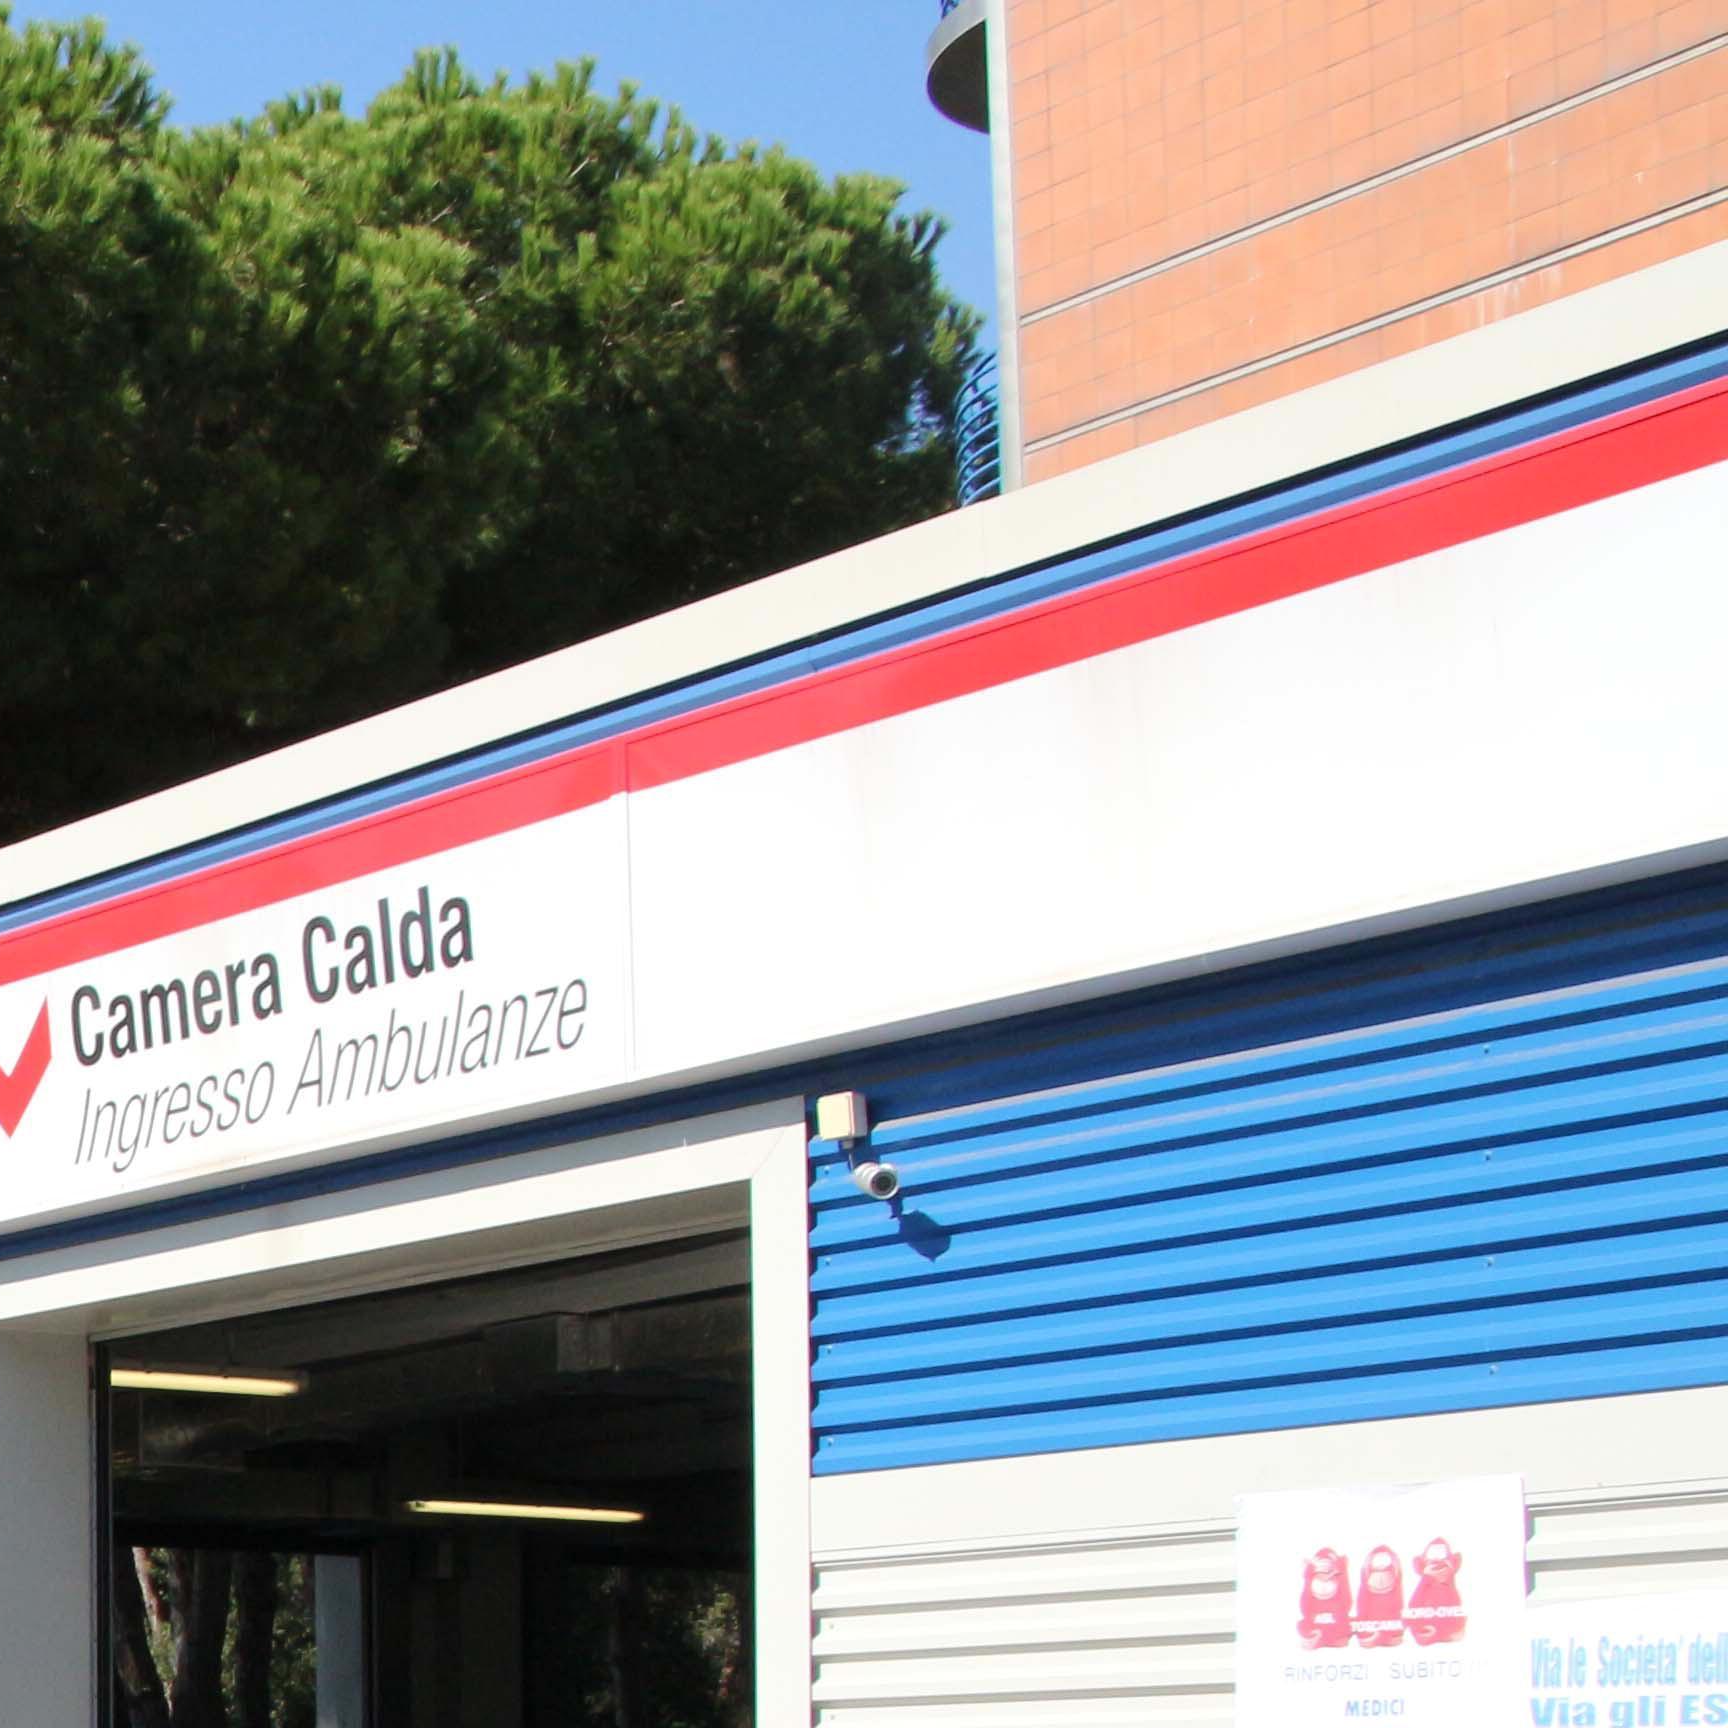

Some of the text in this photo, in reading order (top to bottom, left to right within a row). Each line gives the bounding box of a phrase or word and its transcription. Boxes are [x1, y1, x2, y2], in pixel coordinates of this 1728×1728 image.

[71, 886, 473, 1068] Camera Calda
[75, 977, 589, 1173] Ingresso Ambulanze
[1388, 1660, 1462, 1680] SUBITO
[1531, 1637, 1562, 1688] Via
[1567, 1637, 1588, 1688] le
[1344, 1698, 1405, 1717] MEDICI
[1531, 1696, 1597, 1728] Via
